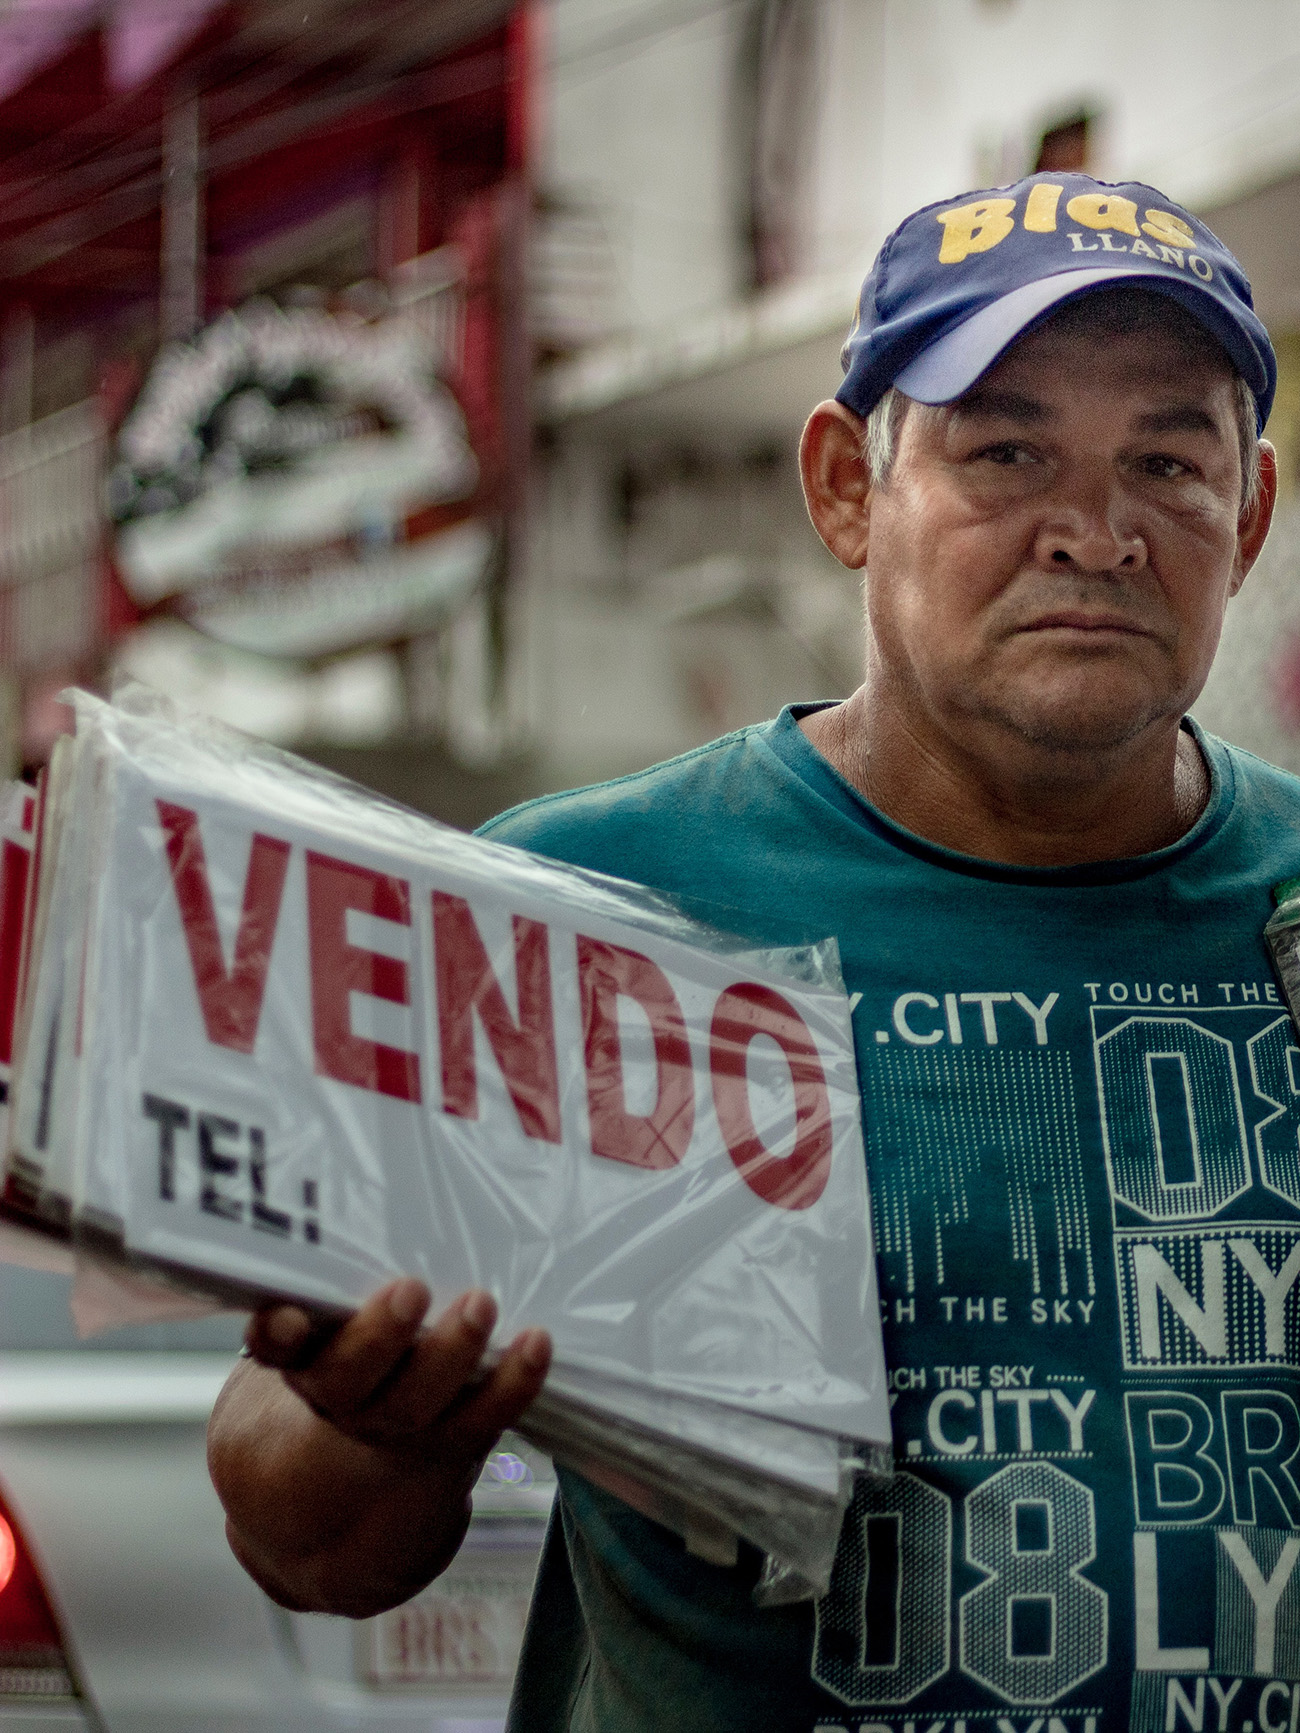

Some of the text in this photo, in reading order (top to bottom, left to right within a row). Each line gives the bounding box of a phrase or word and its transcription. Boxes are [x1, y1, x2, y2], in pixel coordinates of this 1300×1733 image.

[937, 182, 1196, 264] Blas
[1067, 232, 1213, 282] LLANO
[154, 798, 833, 1210] VENDO
[849, 992, 1060, 1045] .CITY
[1083, 982, 1280, 1004] TOUCH THE
[939, 1296, 1008, 1323] THE
[1031, 1297, 1095, 1324] SKY
[934, 1365, 982, 1388] THE
[989, 1364, 1034, 1388] SKY
[811, 1461, 1109, 1706] 08
